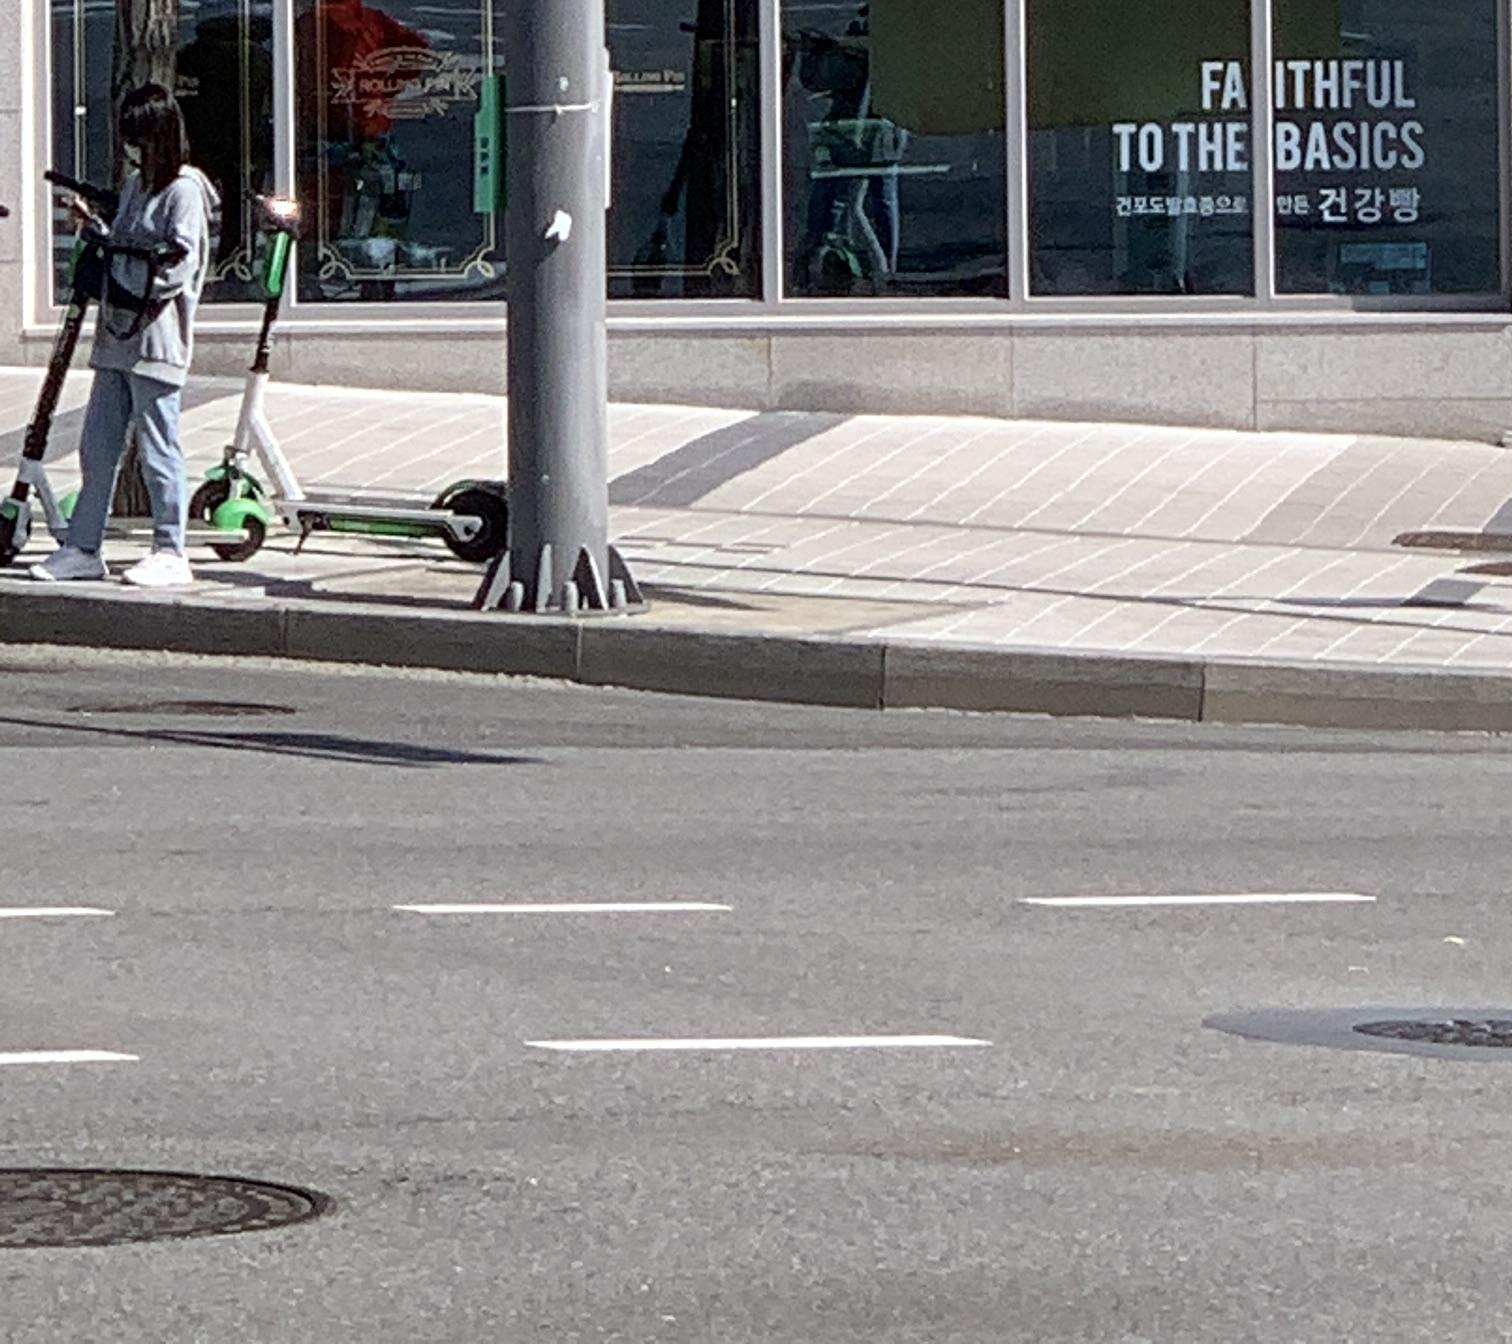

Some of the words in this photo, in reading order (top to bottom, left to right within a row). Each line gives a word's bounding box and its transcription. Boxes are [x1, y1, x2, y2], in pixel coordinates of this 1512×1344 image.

[1112, 123, 1164, 172] TO
[1170, 122, 1249, 172] THE
[1276, 120, 1425, 172] BASICS
[1318, 187, 1421, 223] 건강빵
